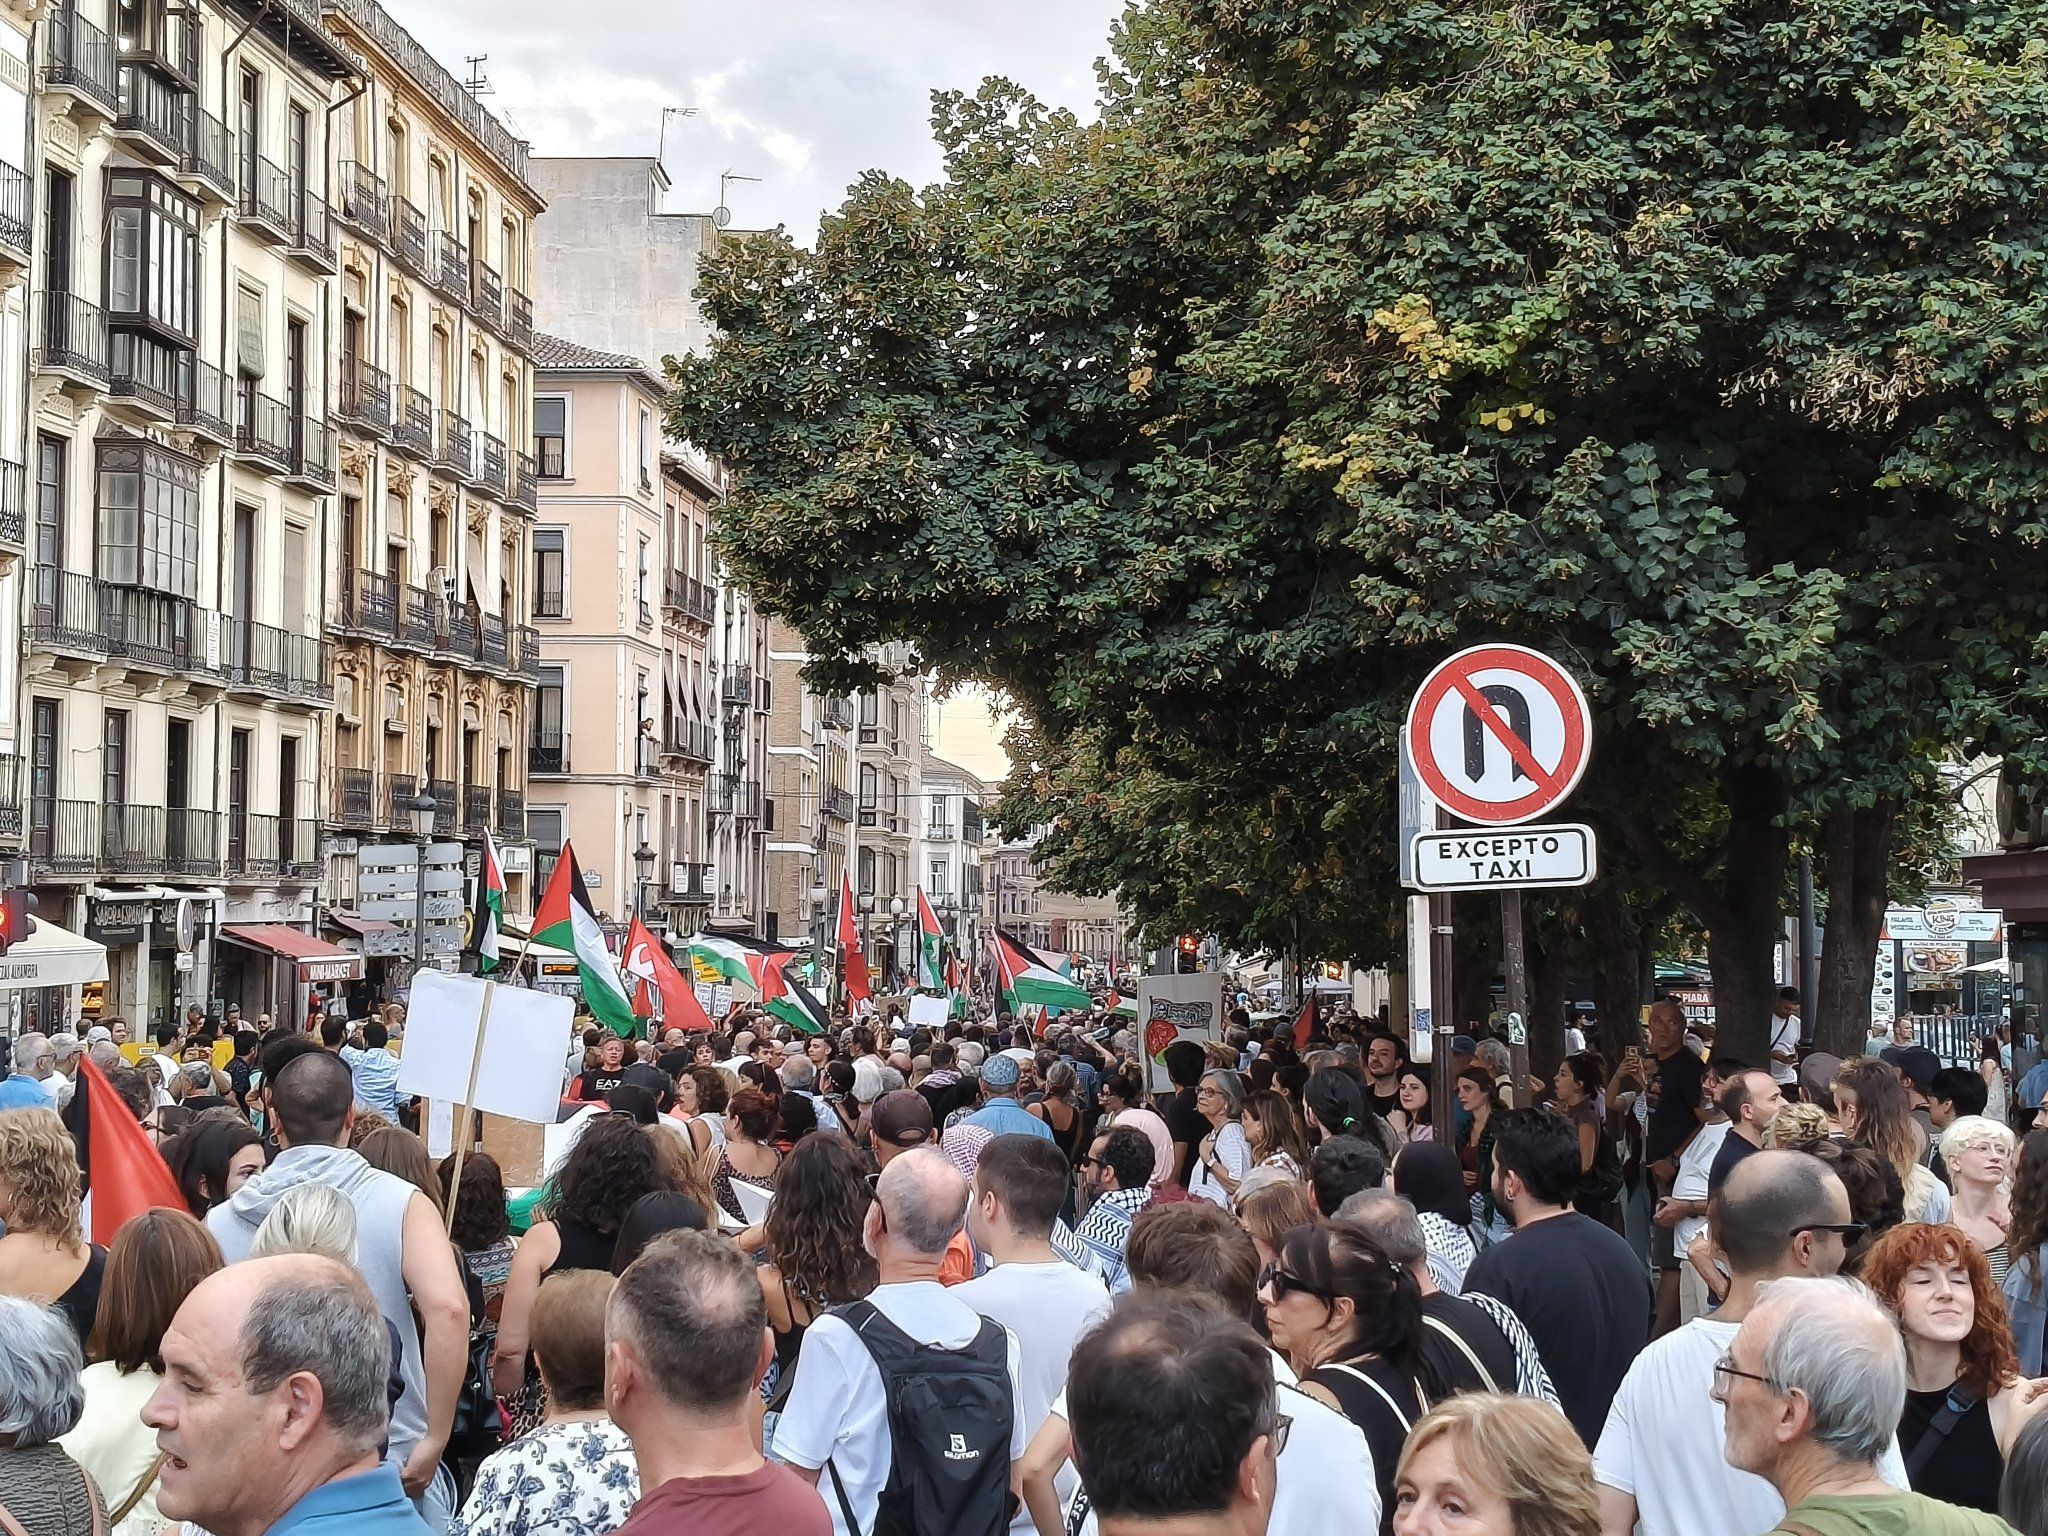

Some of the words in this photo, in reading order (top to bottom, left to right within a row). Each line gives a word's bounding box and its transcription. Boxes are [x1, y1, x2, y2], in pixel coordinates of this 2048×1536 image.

[1438, 836, 1560, 860] EXCEPTO
[1469, 859, 1532, 880] TAXI
[1931, 914, 1956, 926] KING
[310, 962, 351, 980] MINI-MARKET
[595, 1078, 622, 1091] EA7
[1070, 1492, 1089, 1521] SSE
